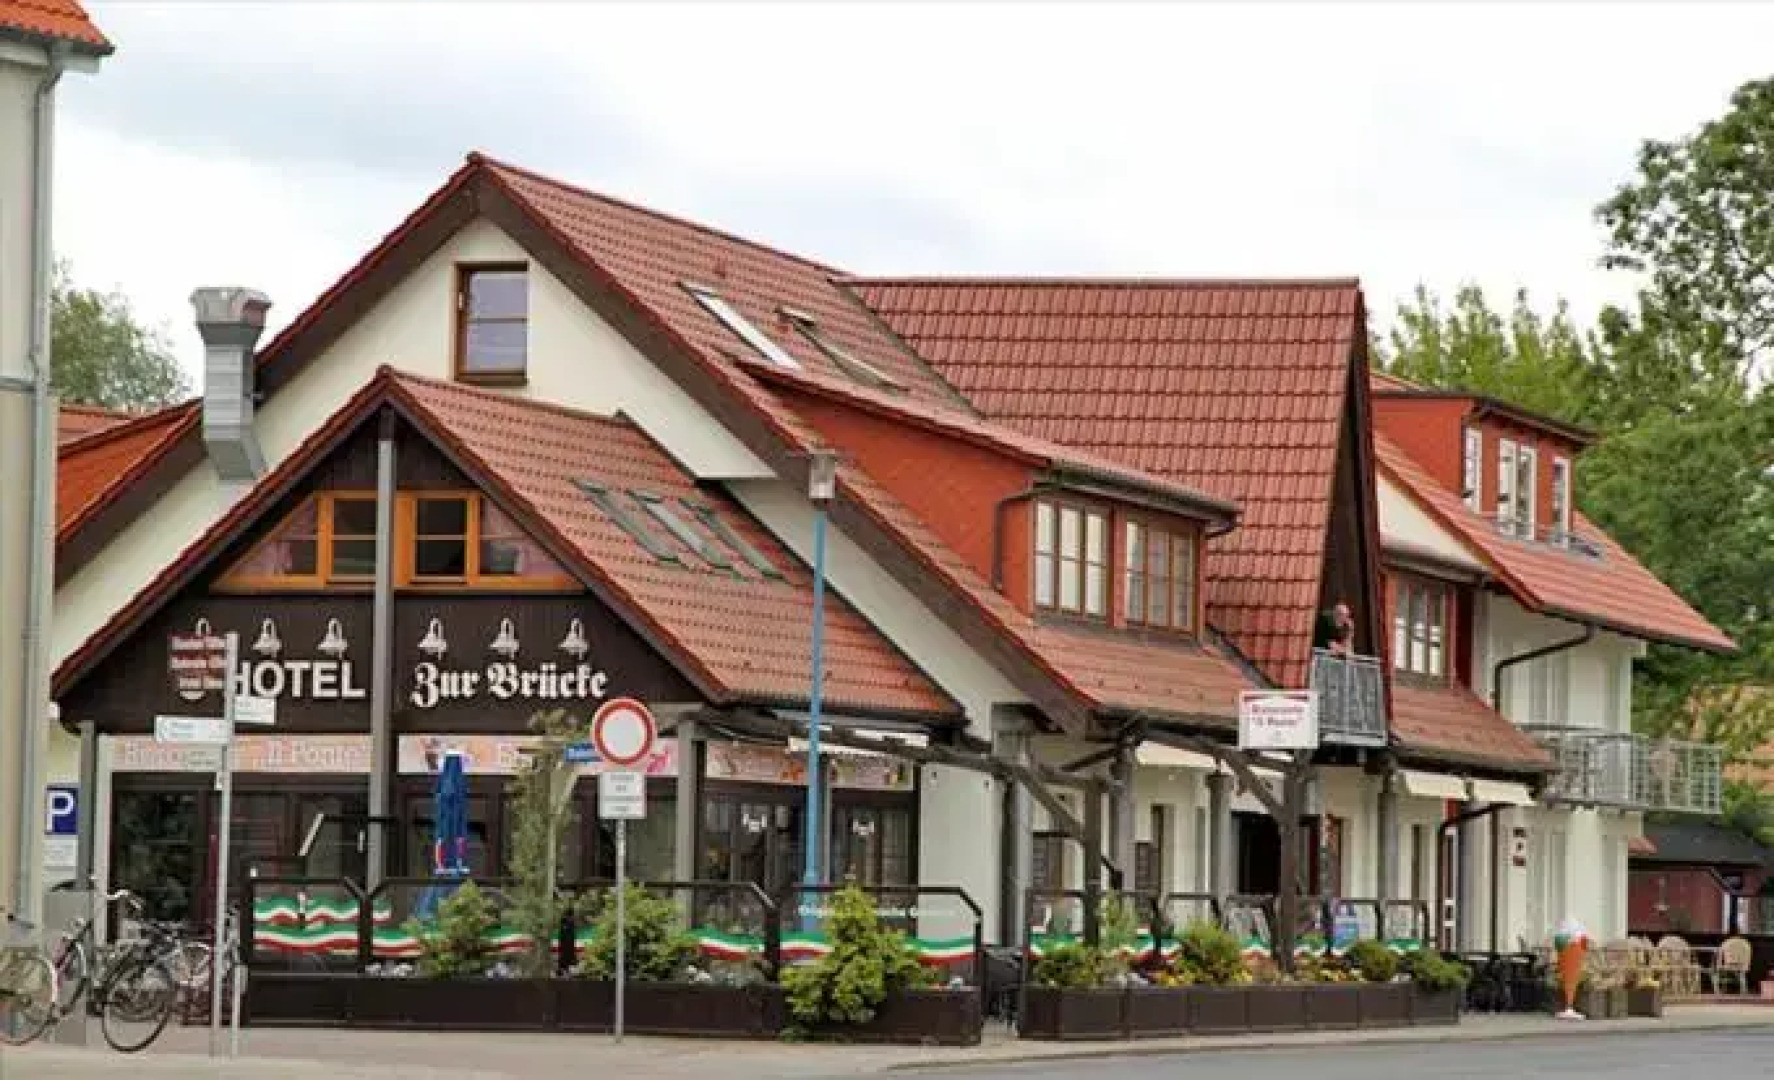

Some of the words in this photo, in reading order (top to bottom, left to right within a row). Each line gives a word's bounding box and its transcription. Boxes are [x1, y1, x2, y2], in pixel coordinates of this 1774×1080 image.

[232, 661, 366, 697] HOTEL
[410, 662, 480, 707] Zur
[487, 661, 608, 698] Brücke
[46, 792, 74, 831] P
